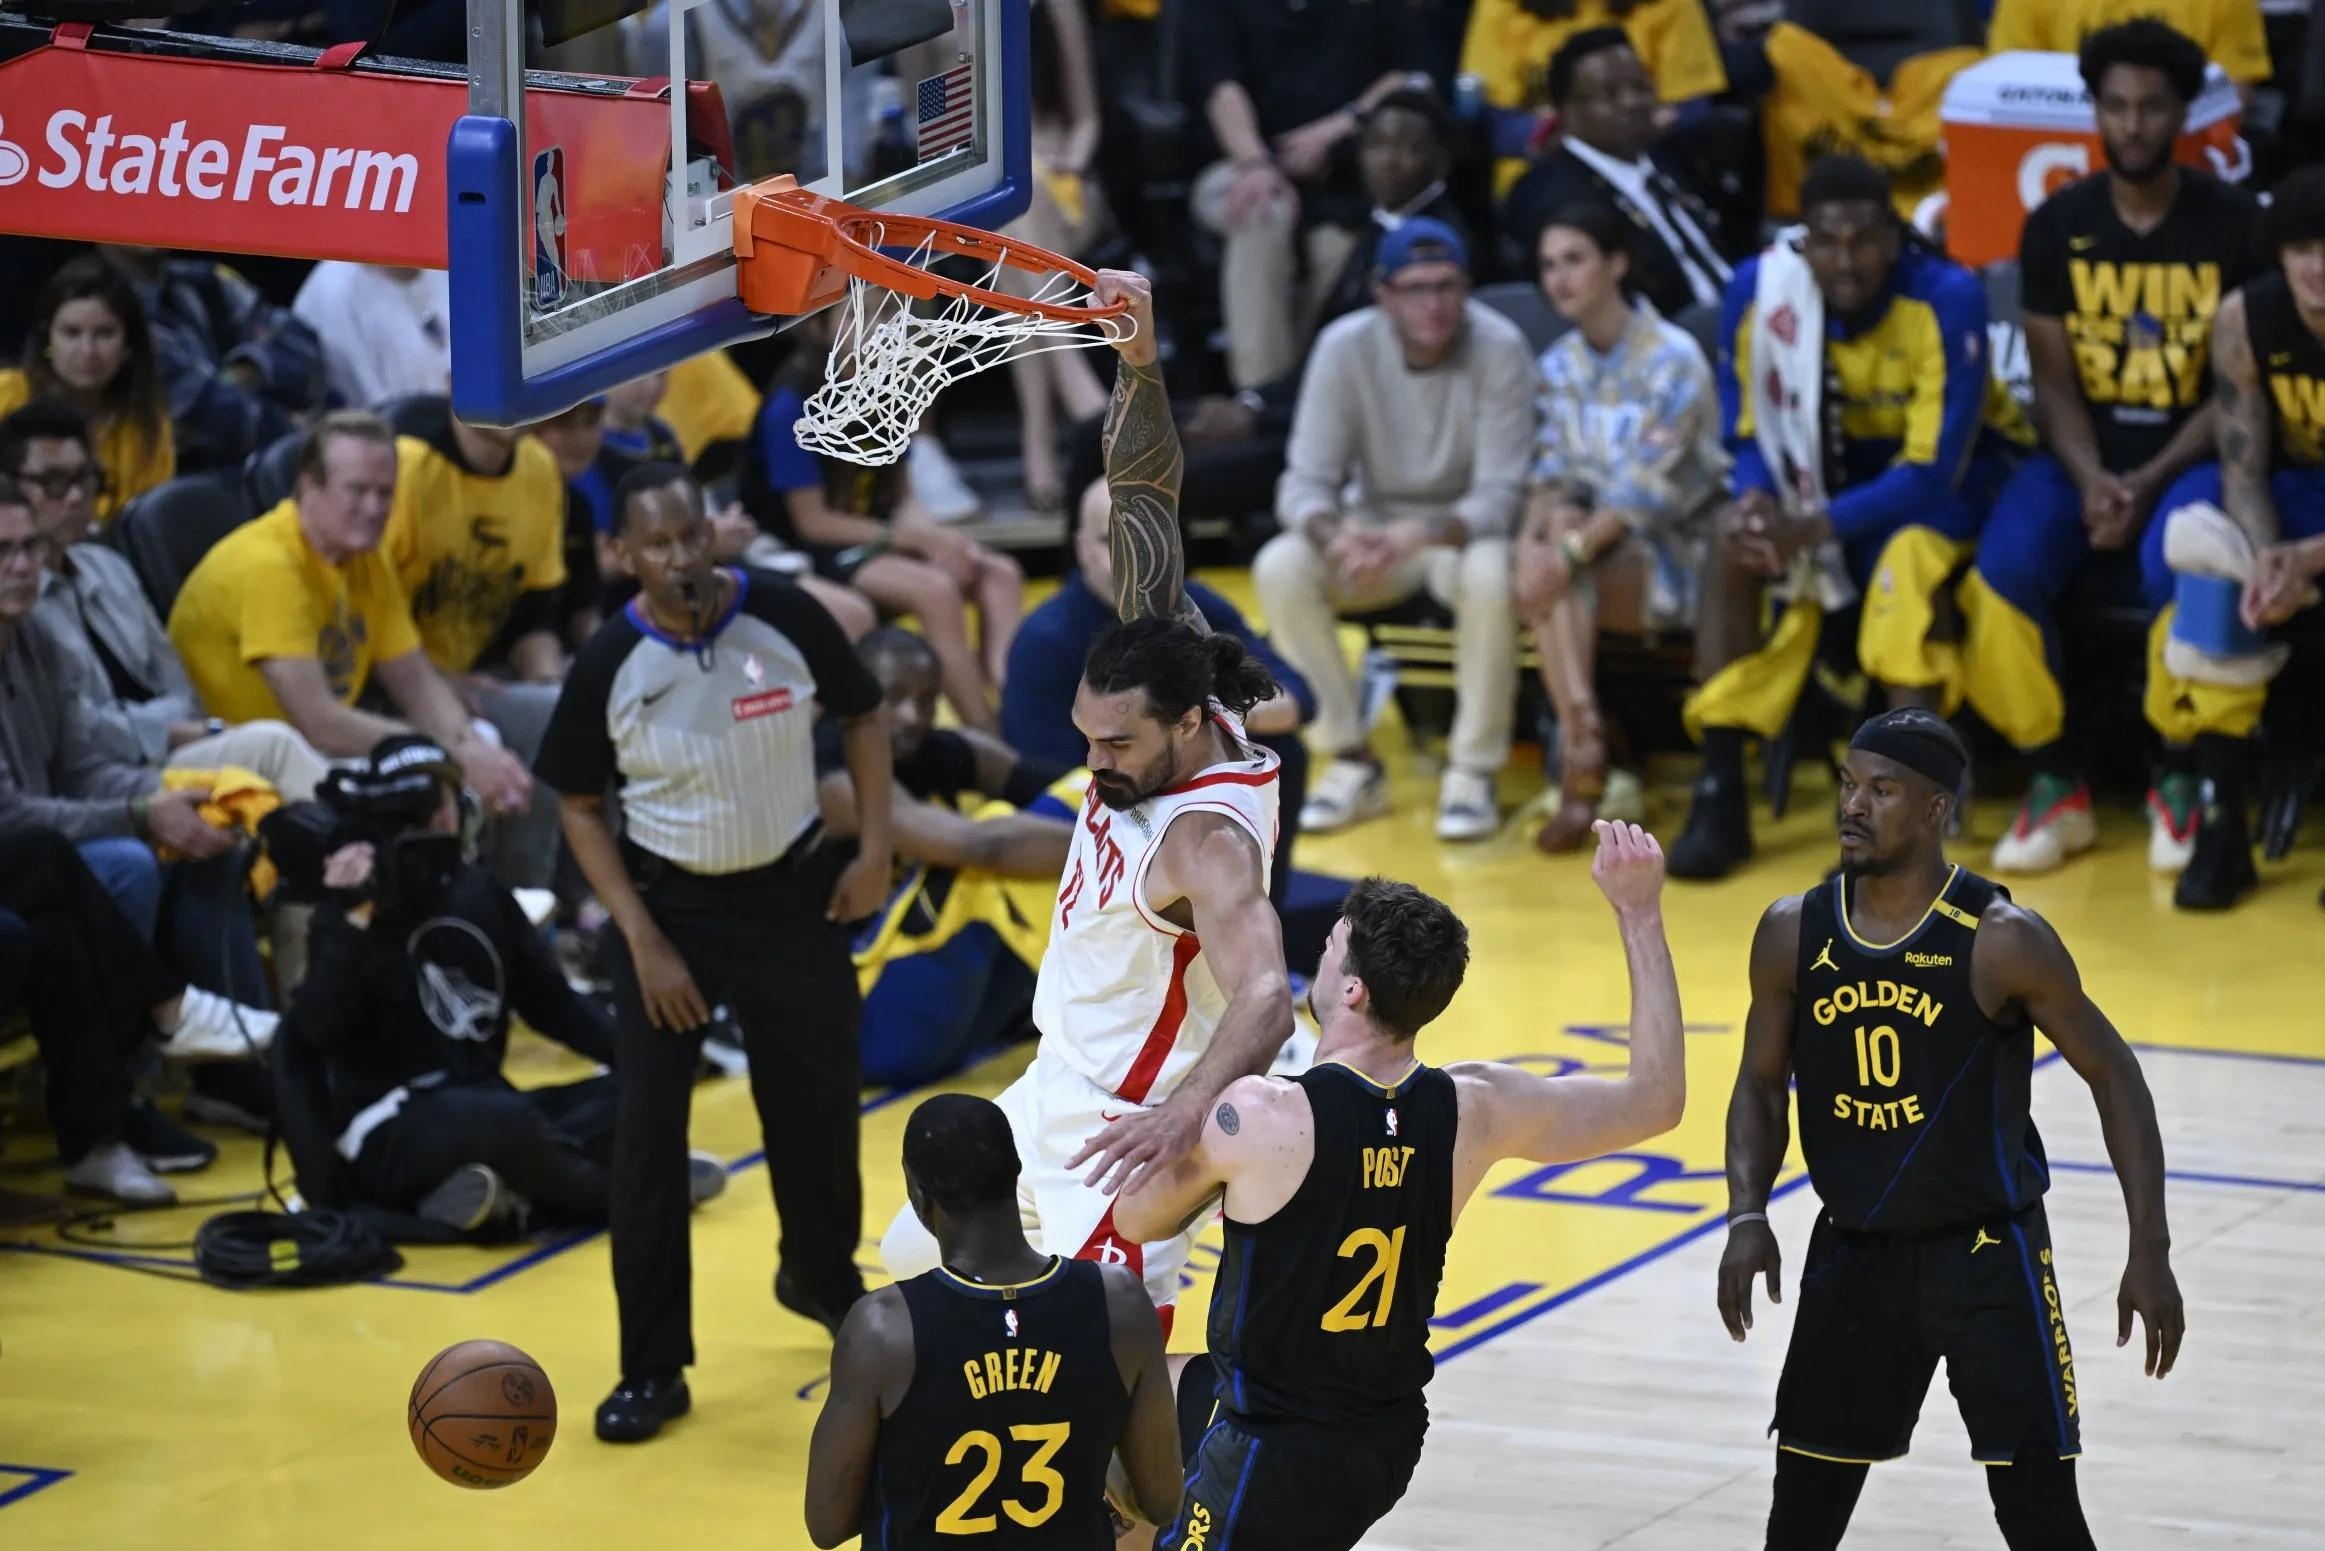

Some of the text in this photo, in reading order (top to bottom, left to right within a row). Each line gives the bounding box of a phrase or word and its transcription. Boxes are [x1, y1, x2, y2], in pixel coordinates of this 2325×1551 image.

[539, 269, 556, 299] NBA
[2069, 259, 2220, 316] WIN
[1904, 951, 1952, 966] Rakuten
[1813, 980, 1944, 1027] GOLDEN
[1855, 1025, 1900, 1088] 10
[1833, 1093, 1925, 1131] STATE
[1362, 1146, 1416, 1189] POST
[1320, 1225, 1407, 1333] 21
[963, 1348, 1062, 1400] GREEN
[935, 1421, 1071, 1535] 23
